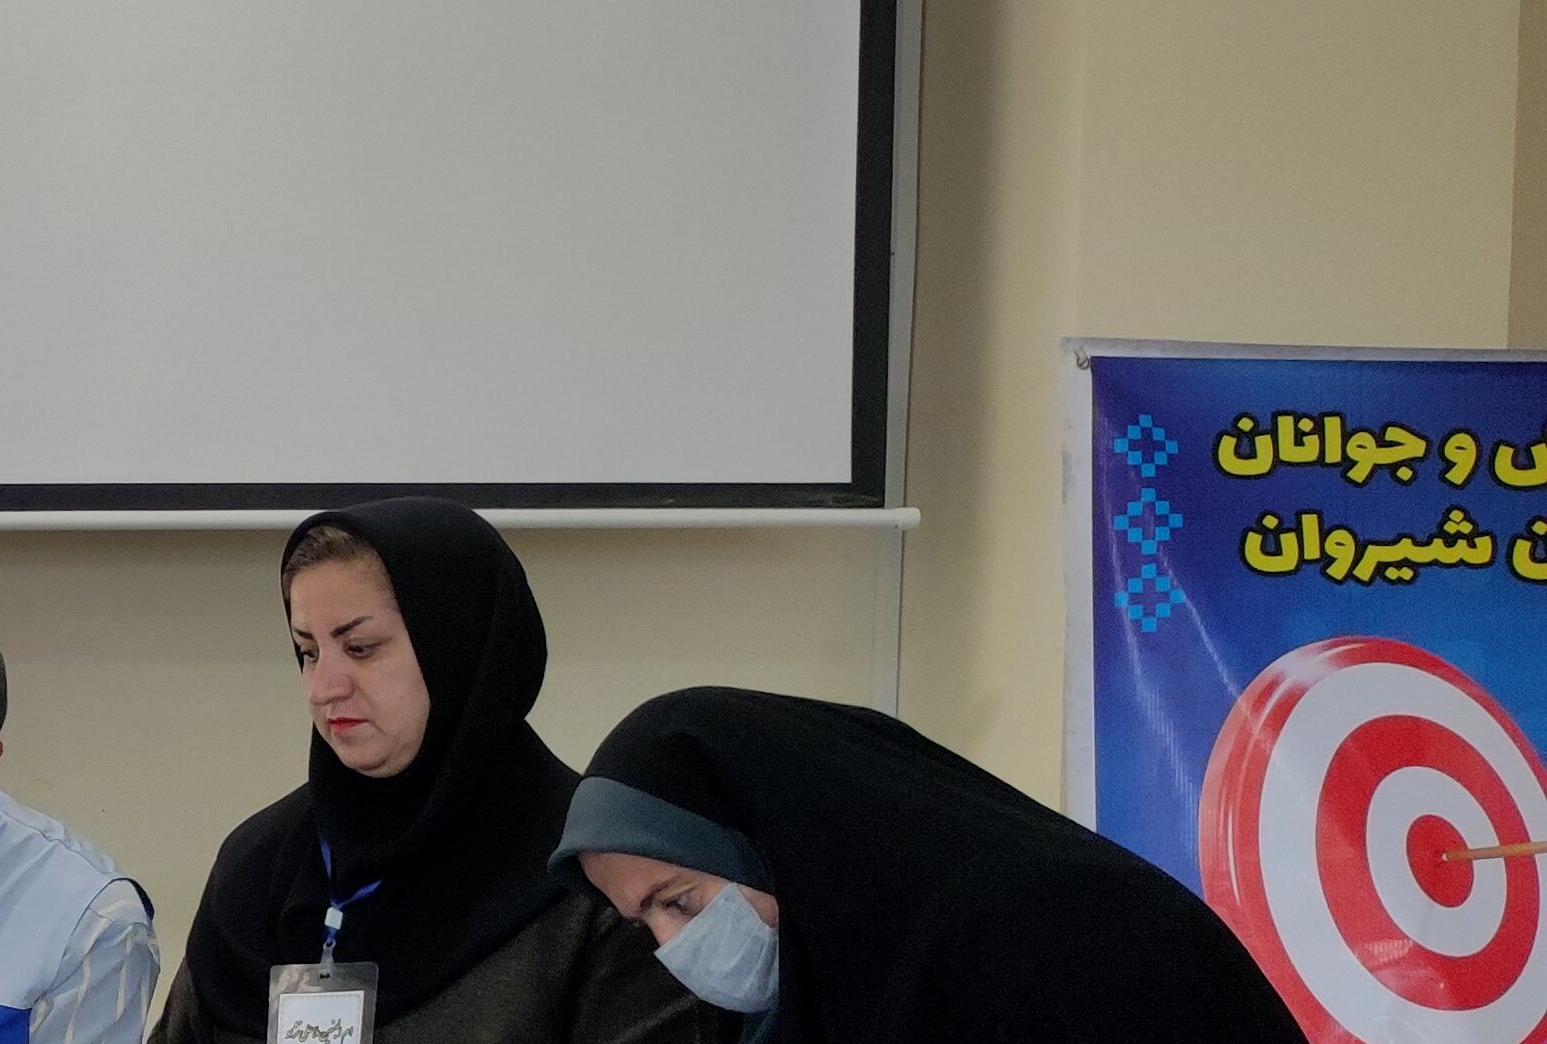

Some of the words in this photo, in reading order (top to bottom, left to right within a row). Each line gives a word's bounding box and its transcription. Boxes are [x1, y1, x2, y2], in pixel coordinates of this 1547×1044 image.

[1217, 415, 1428, 484] جوانان
[1443, 431, 1478, 485] و
[1244, 508, 1494, 582] شیروان
